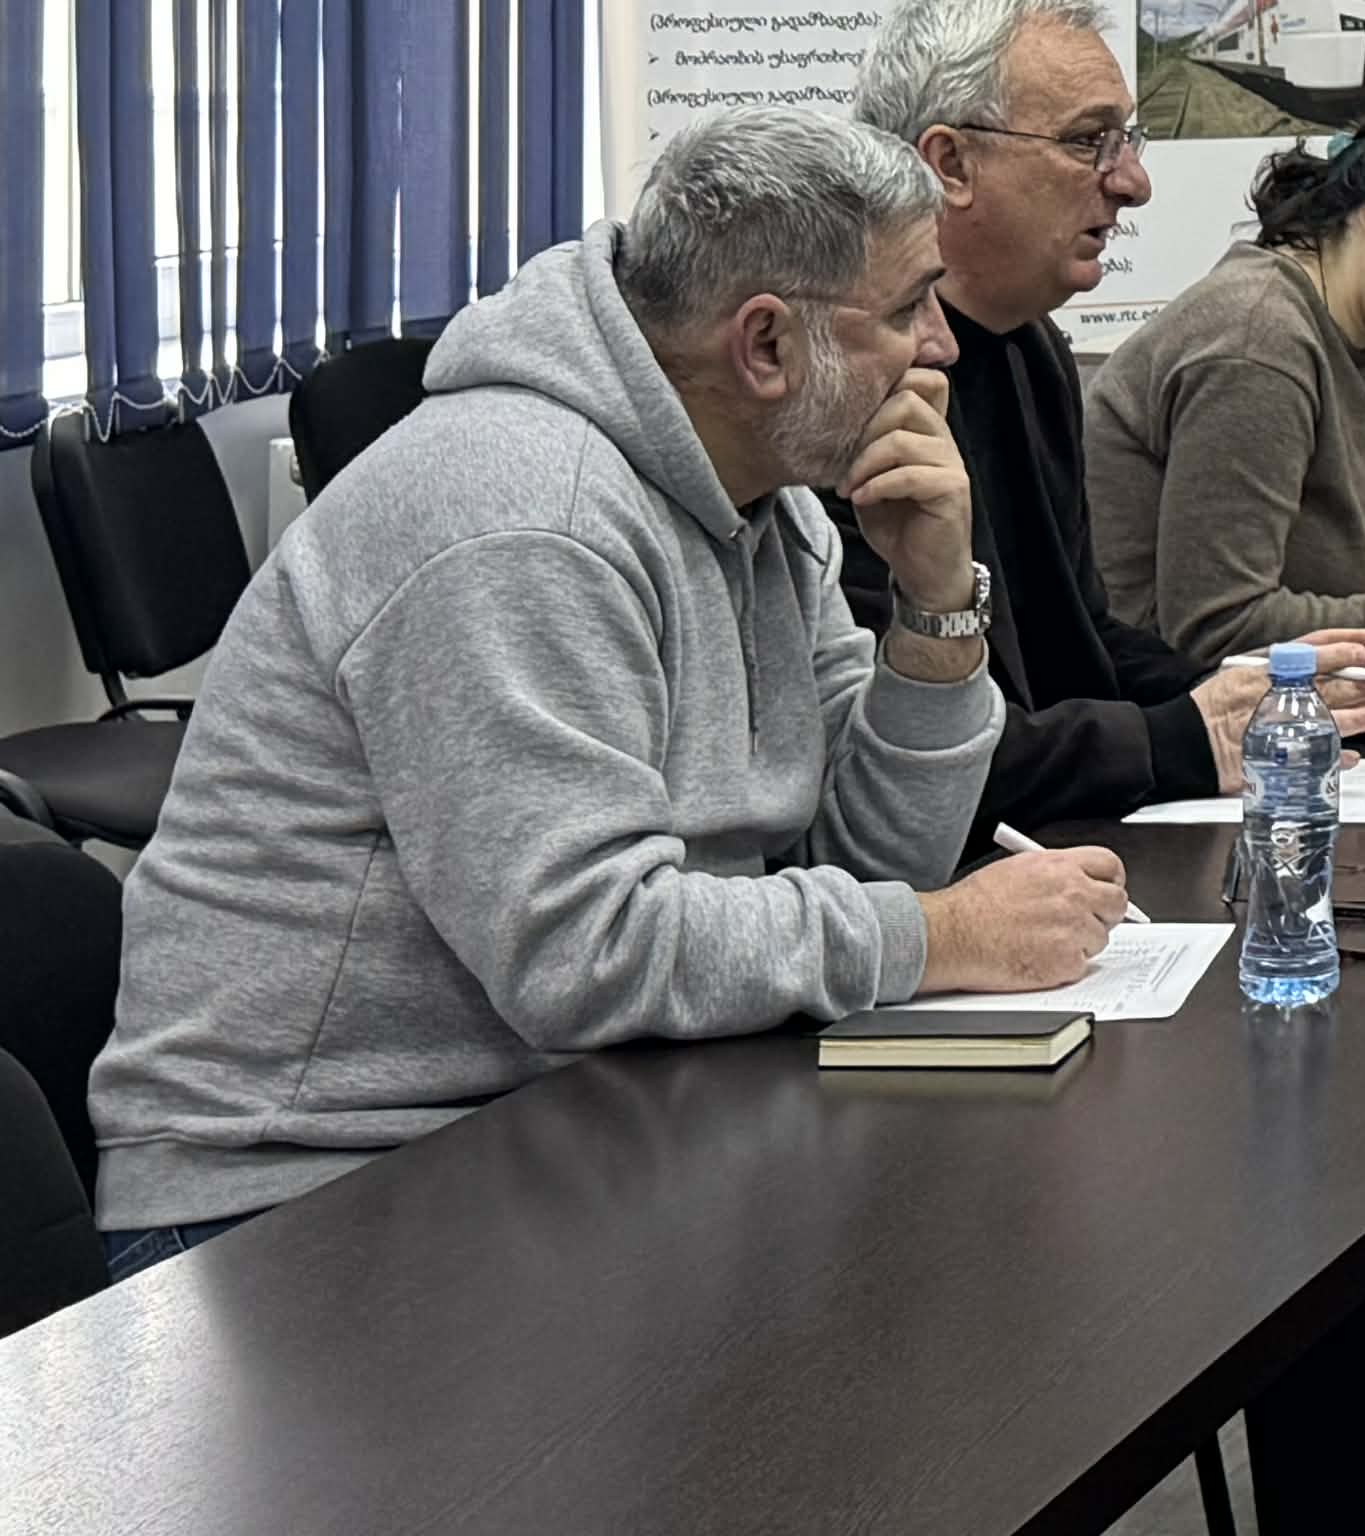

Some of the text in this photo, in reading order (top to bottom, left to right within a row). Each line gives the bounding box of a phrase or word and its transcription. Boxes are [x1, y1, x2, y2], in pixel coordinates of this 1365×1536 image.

[650, 12, 767, 33] (პროფესიული
[675, 49, 764, 66] მოძრაობის
[647, 87, 764, 108] (პროფესიული
